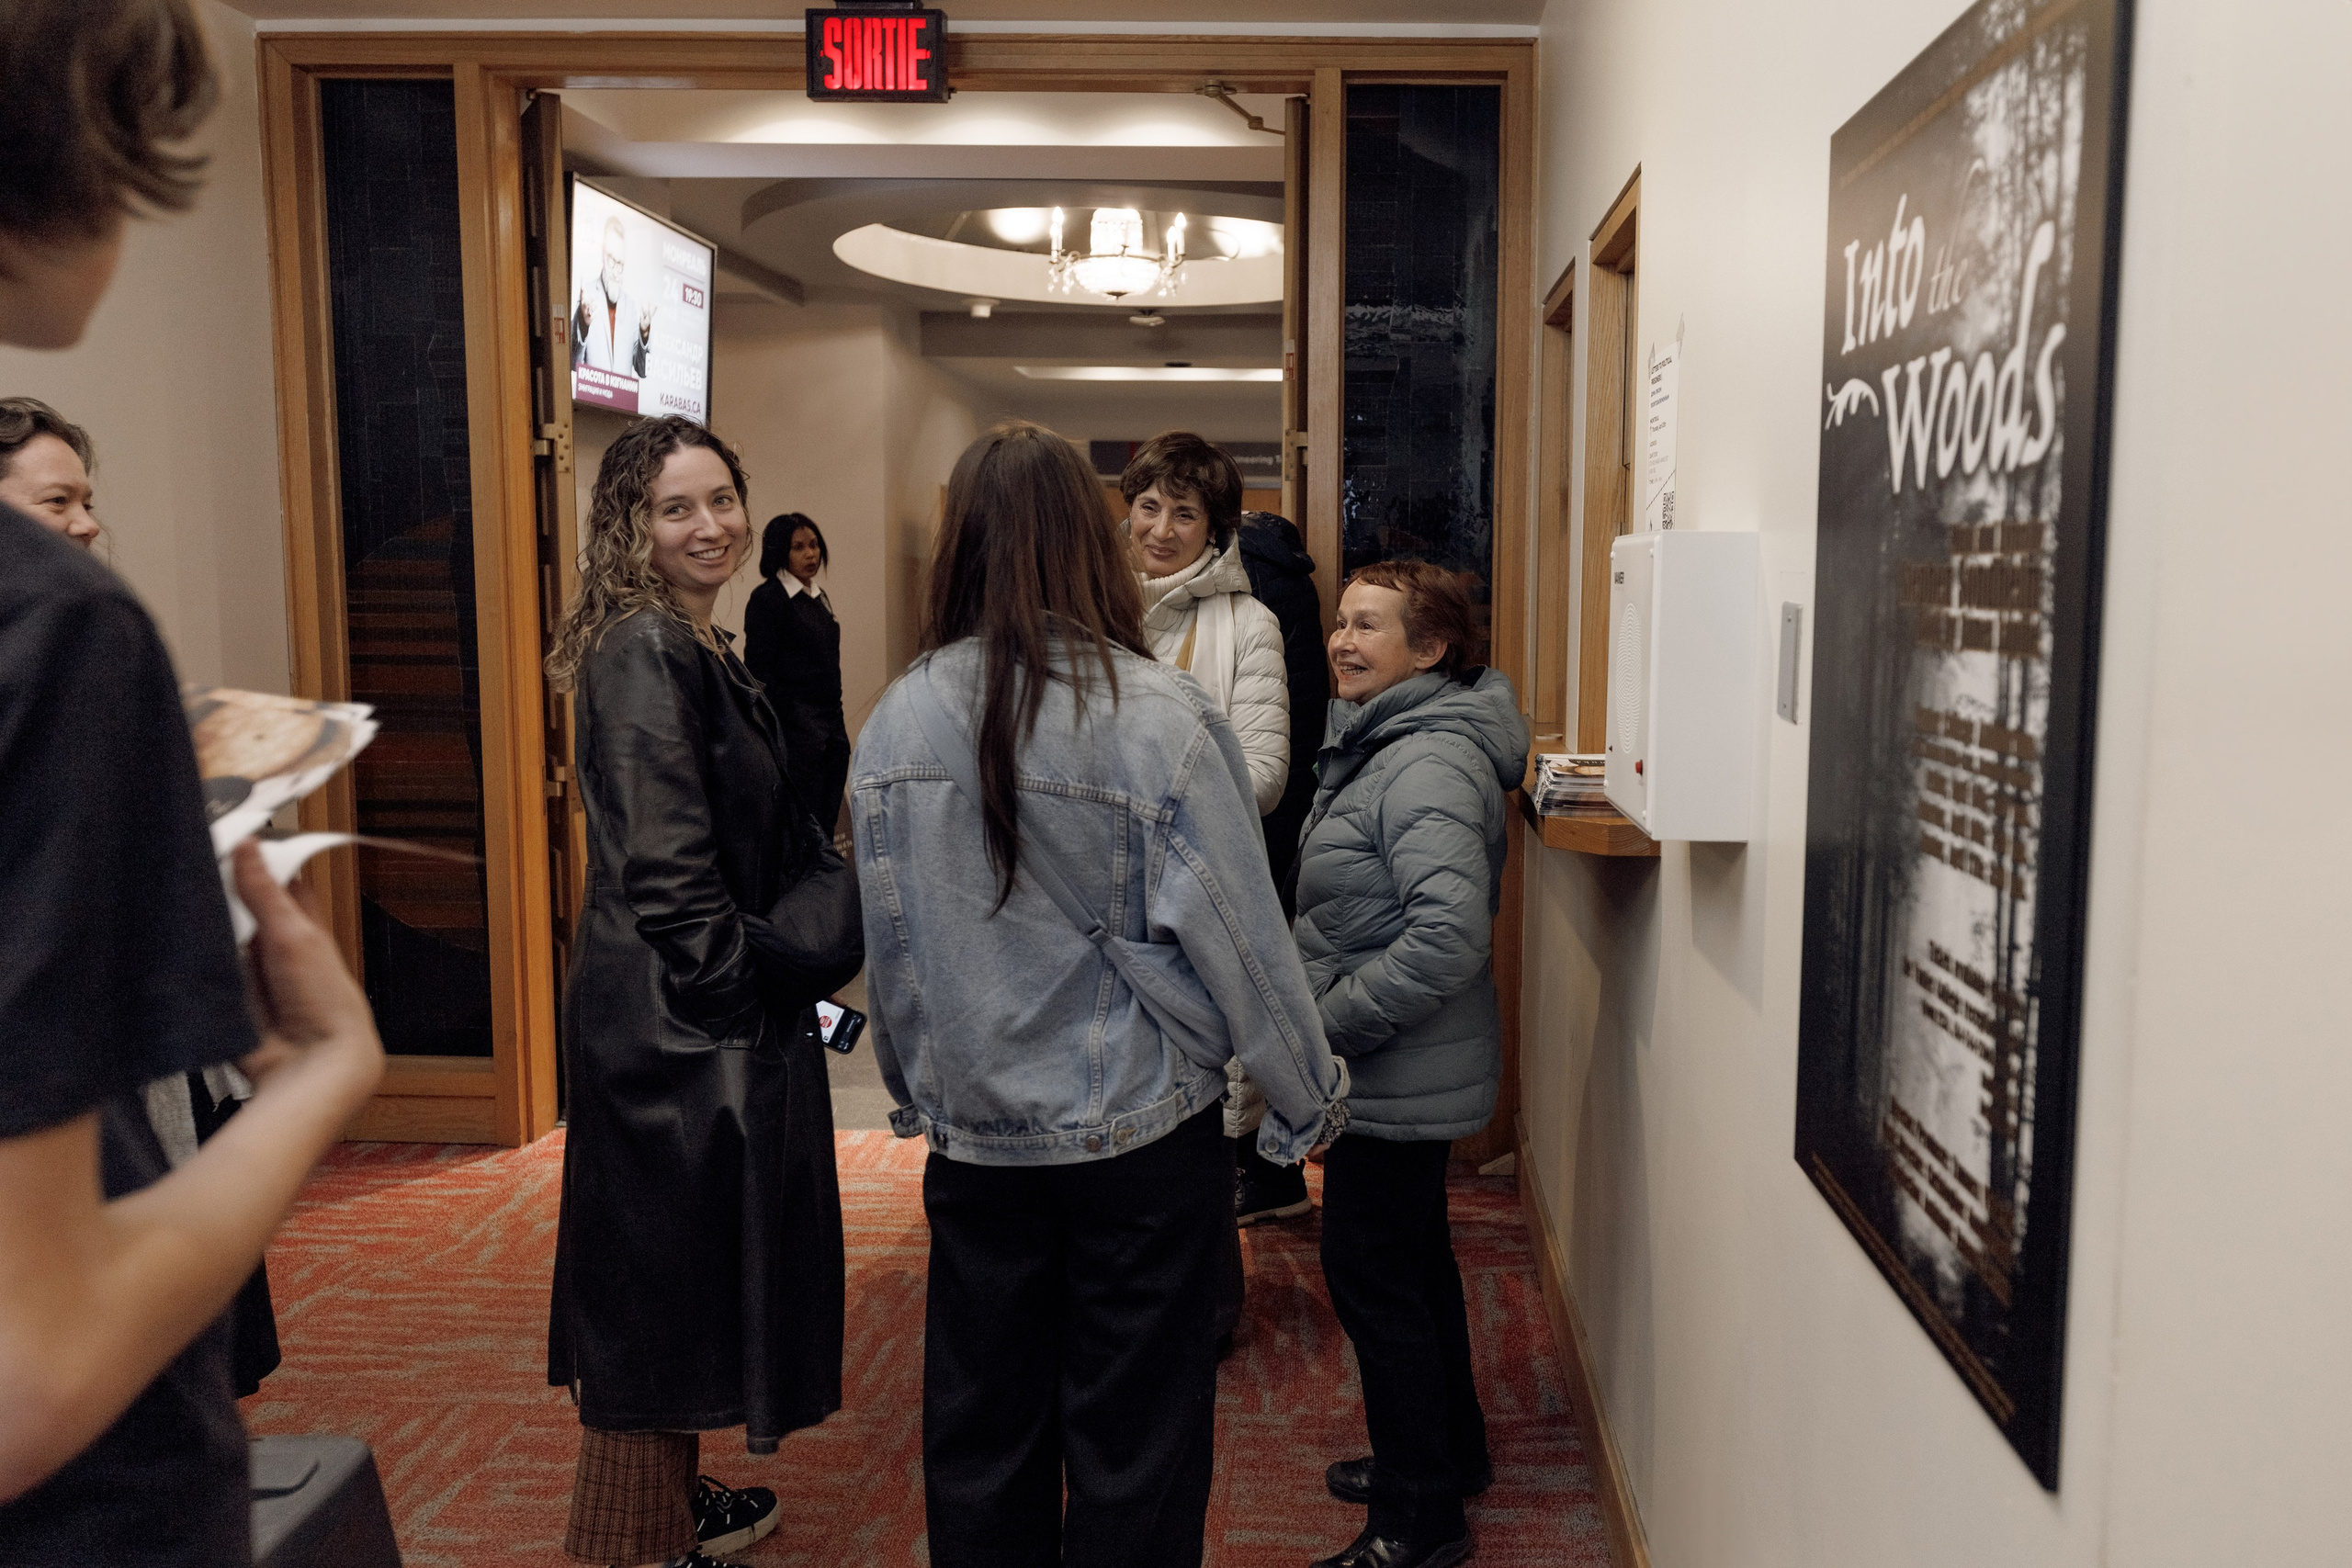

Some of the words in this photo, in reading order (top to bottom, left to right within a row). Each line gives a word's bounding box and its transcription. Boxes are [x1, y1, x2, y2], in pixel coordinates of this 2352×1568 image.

[823, 17, 927, 90] SORTIE
[1841, 193, 1925, 355] Into
[1928, 158, 1986, 314] the
[646, 353, 703, 391] ВАСИЛЬЕВ
[1882, 220, 2066, 494] Woods
[660, 391, 701, 414] KARABAS.CA
